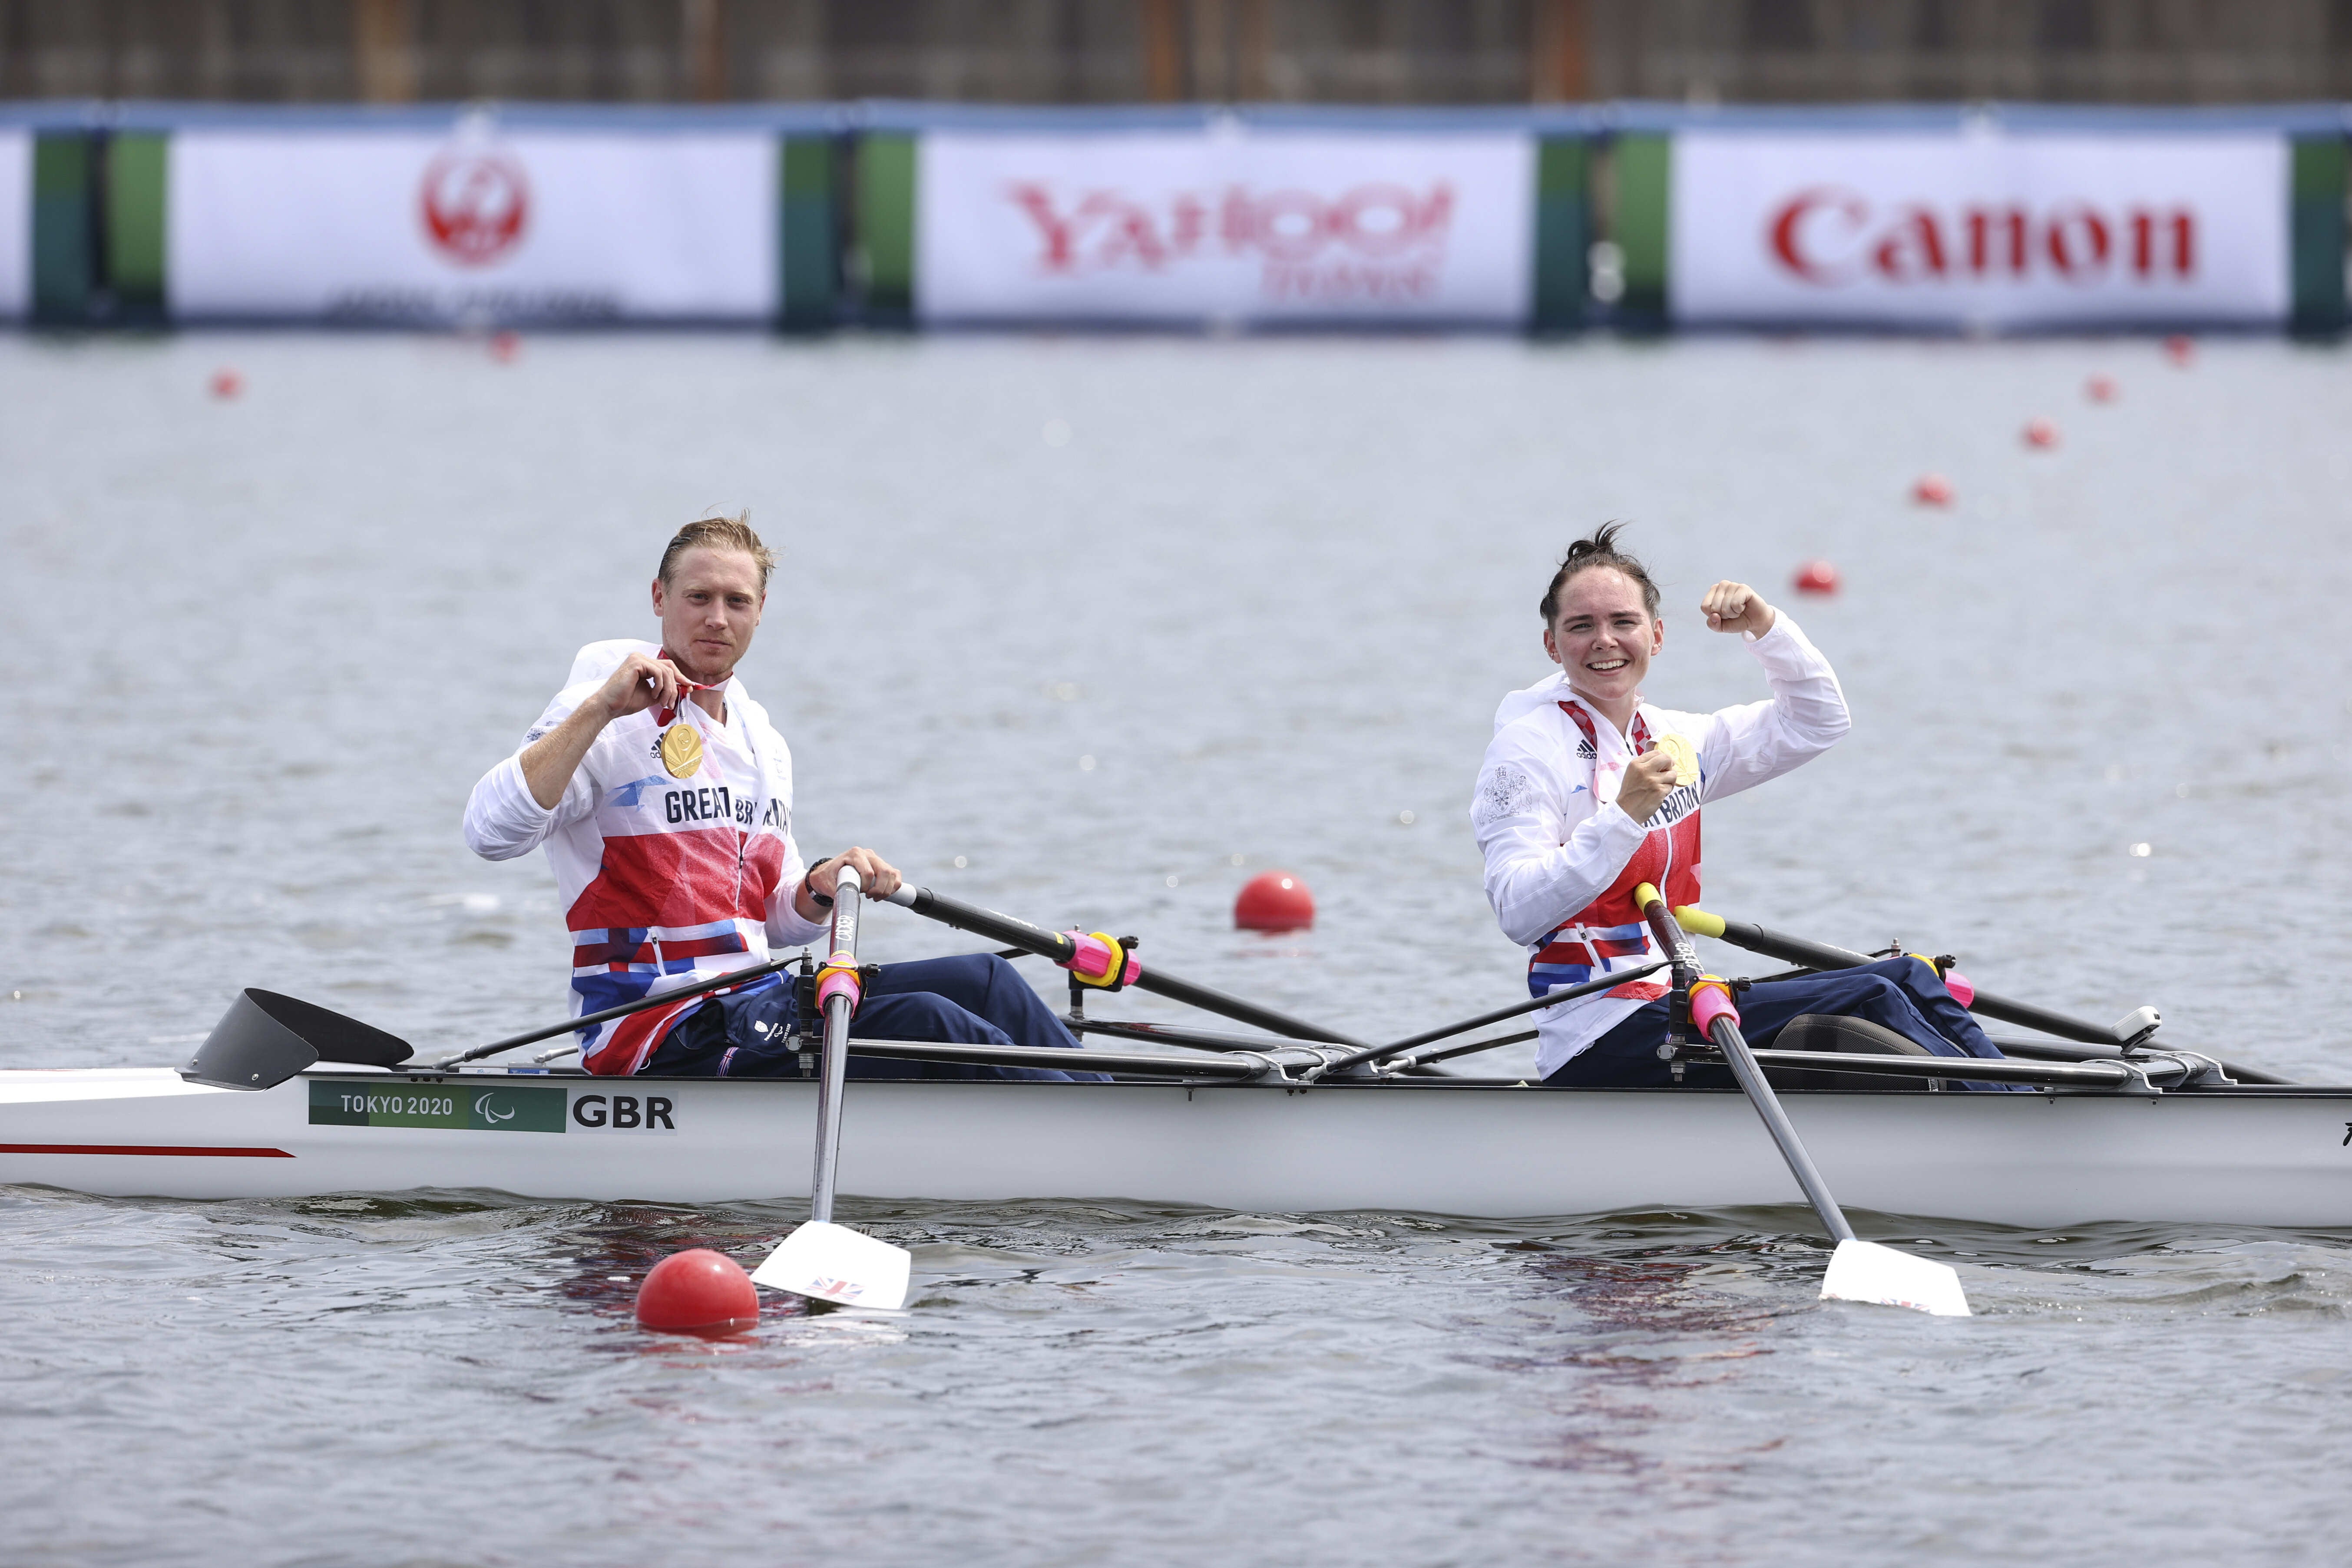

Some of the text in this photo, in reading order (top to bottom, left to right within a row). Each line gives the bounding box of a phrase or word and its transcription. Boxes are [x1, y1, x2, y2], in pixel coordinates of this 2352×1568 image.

[1004, 178, 1454, 276] YAHOO!
[1764, 184, 2197, 288] Canon
[665, 787, 731, 824] GREAT
[341, 1095, 453, 1115] TOKYO 2020
[573, 1095, 675, 1129] GBR
